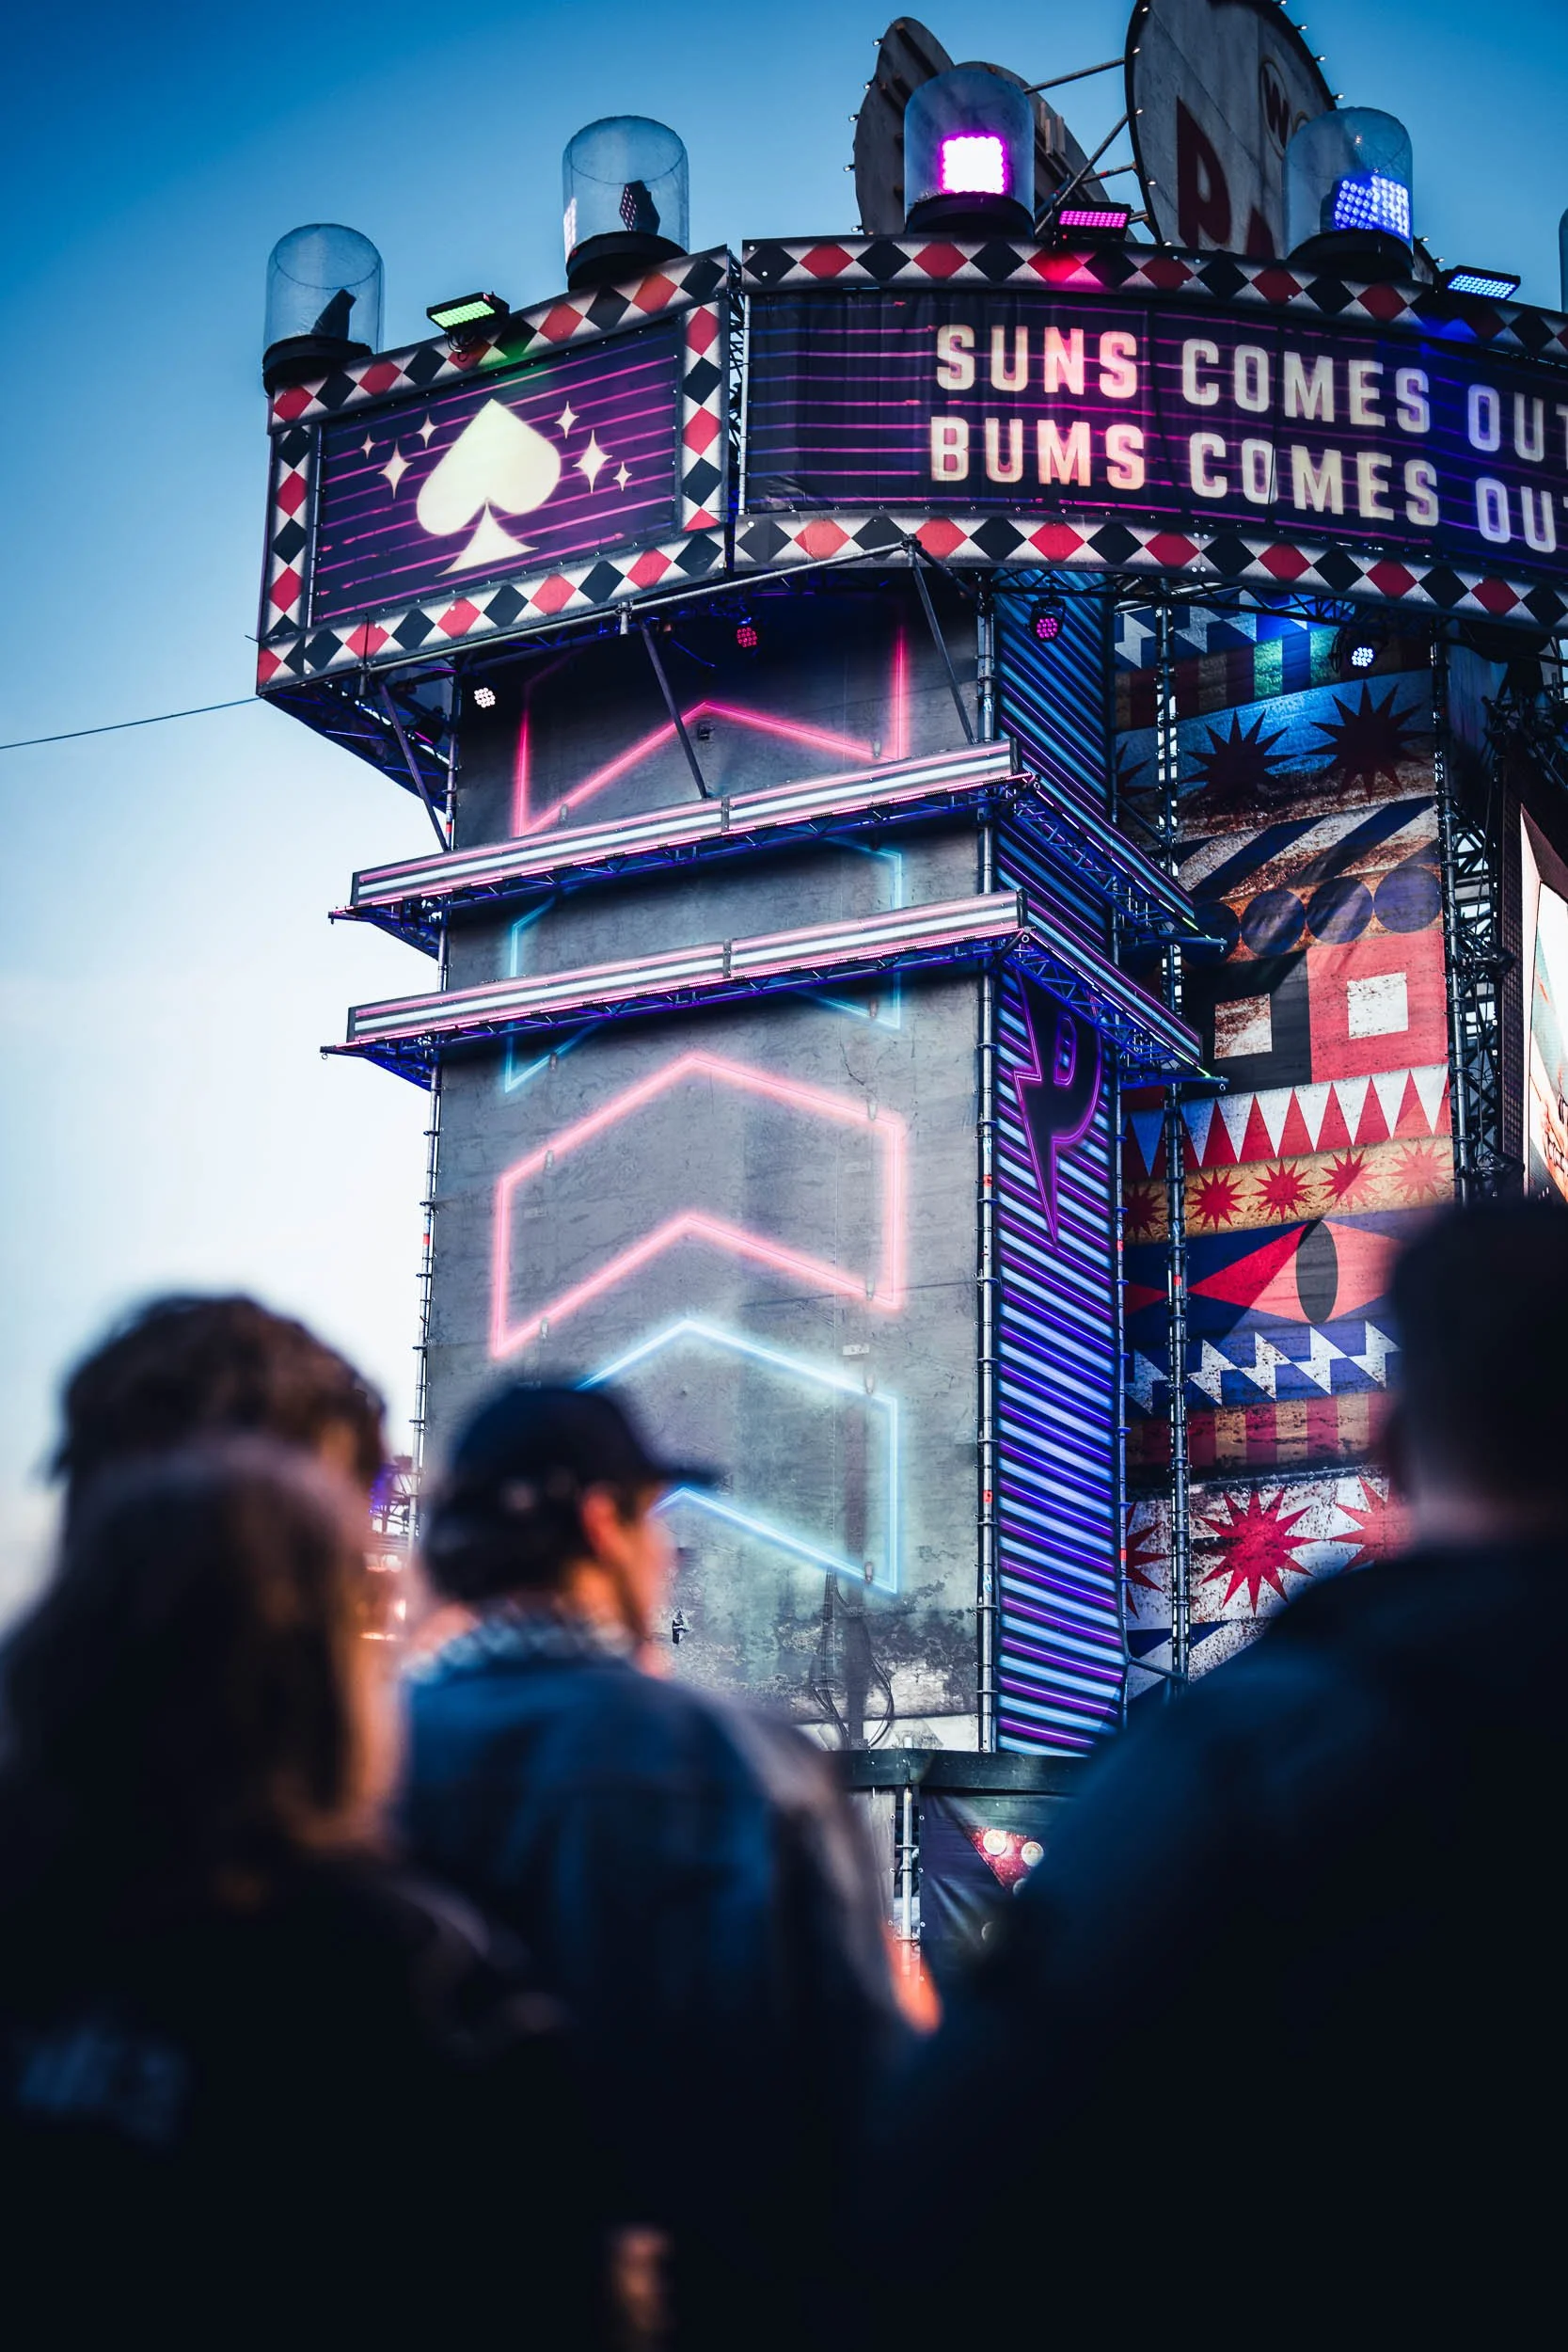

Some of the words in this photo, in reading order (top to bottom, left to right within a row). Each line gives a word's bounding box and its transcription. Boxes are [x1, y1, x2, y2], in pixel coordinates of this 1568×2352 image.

[937, 324, 1137, 398] SUNS
[1182, 339, 1431, 434] COMES
[930, 417, 1146, 490] BUMS
[1189, 432, 1439, 527] COMES
[1475, 477, 1568, 553] OU
